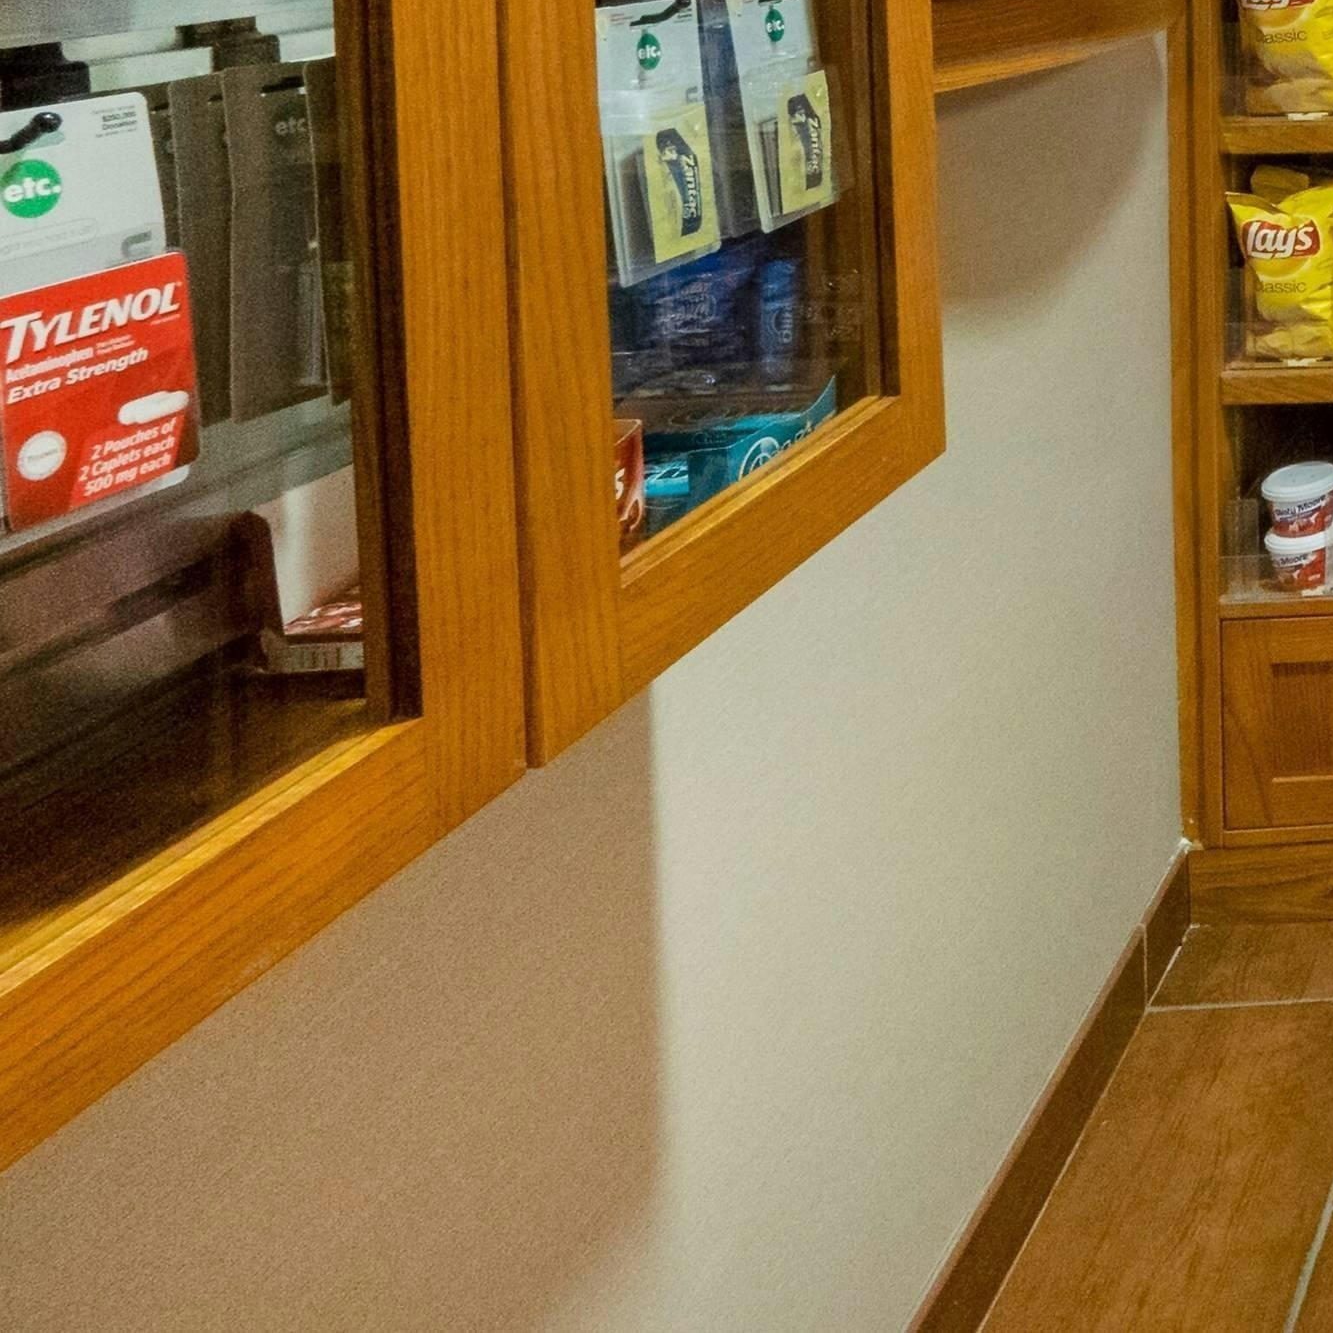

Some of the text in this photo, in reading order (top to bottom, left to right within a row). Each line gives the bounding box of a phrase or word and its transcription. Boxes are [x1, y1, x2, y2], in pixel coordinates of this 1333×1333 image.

[766, 19, 785, 33] etc.
[638, 45, 661, 59] etc.
[3, 177, 62, 203] etc.
[1246, 222, 1315, 259] Lay's
[0, 282, 181, 364] TYLENOL
[7, 347, 149, 405] Extra Strength
[79, 436, 175, 482] 2 Caplets each
[91, 417, 177, 460] 2 Pouches of
[84, 453, 172, 497] 500 mg each
